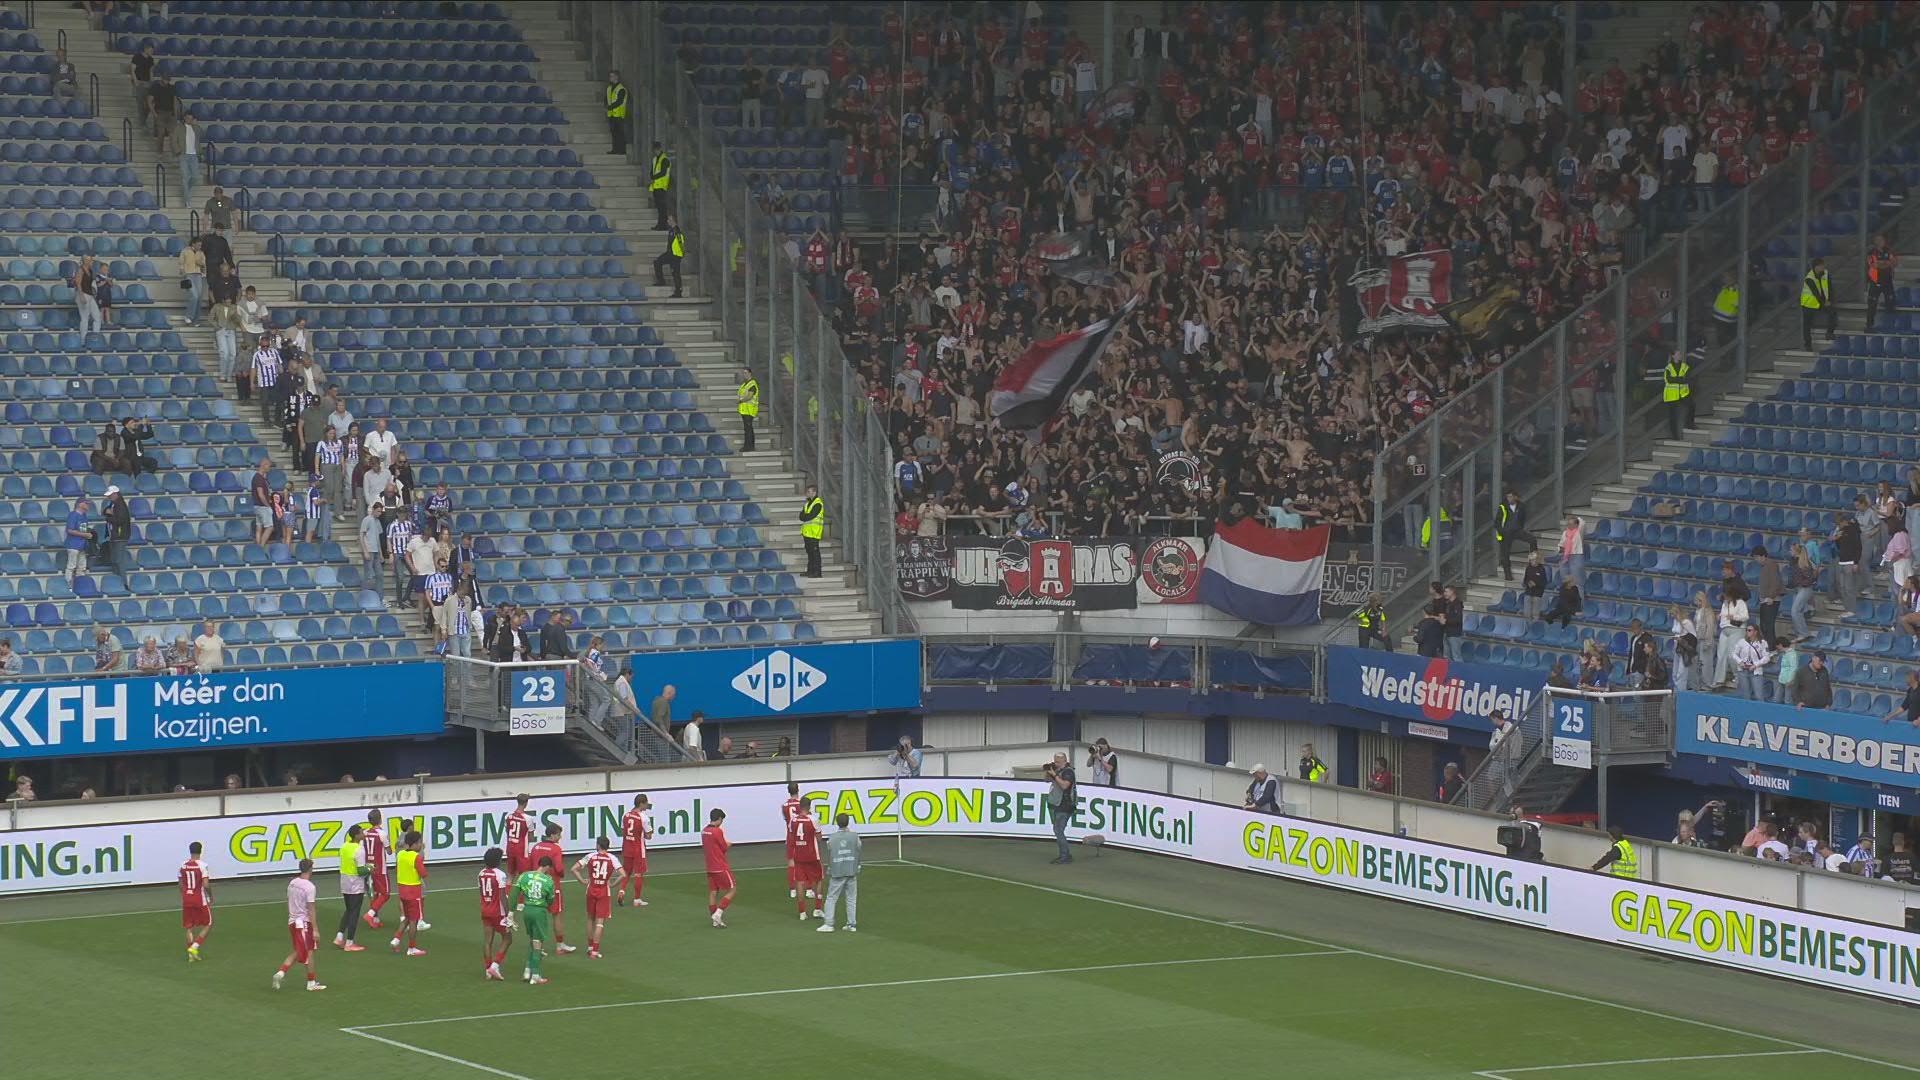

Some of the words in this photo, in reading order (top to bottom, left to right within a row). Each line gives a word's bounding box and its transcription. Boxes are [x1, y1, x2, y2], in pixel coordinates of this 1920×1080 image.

[1156, 585, 1186, 597] LOCALS
[996, 595, 1034, 608] Brigade
[522, 676, 555, 702] 23
[747, 671, 811, 690] VDK
[154, 678, 227, 706] Méér
[233, 677, 284, 702] dan
[154, 712, 267, 742] kozijnen.
[1560, 705, 1584, 733] 25
[1748, 775, 1790, 791] DRINKEN
[1878, 794, 1900, 808] ITEN
[509, 820, 521, 839] 21
[627, 819, 635, 836] 2
[796, 823, 804, 841] 4
[365, 837, 375, 855] 17
[592, 861, 608, 880] 34
[185, 871, 196, 889] 11
[480, 878, 493, 897] 14
